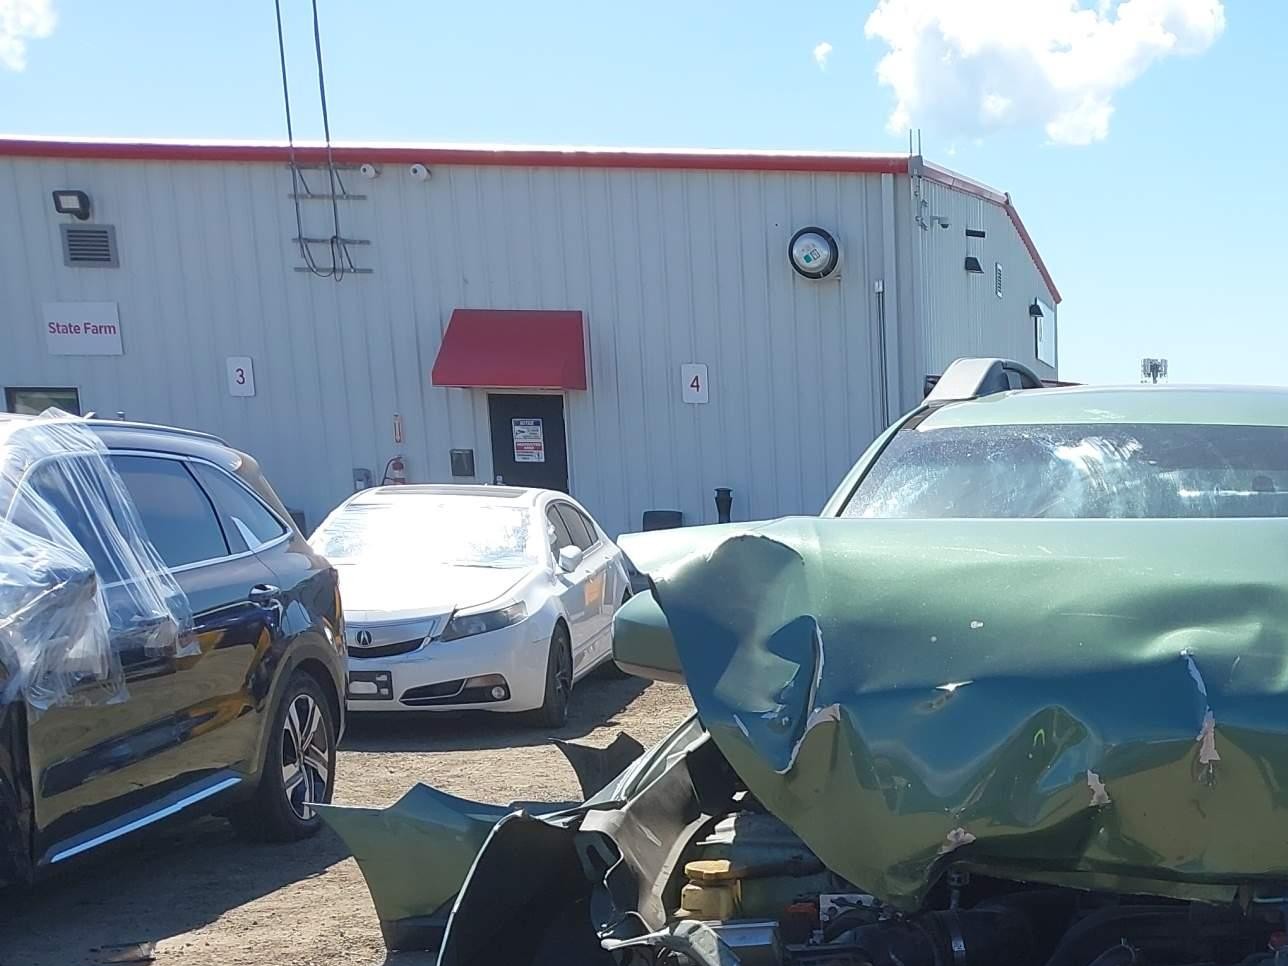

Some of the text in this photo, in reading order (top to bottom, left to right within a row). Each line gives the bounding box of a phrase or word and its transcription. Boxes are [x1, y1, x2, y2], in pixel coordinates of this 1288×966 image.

[48, 322, 116, 334] State Farm
[236, 368, 245, 384] 3
[690, 375, 699, 392] 4
